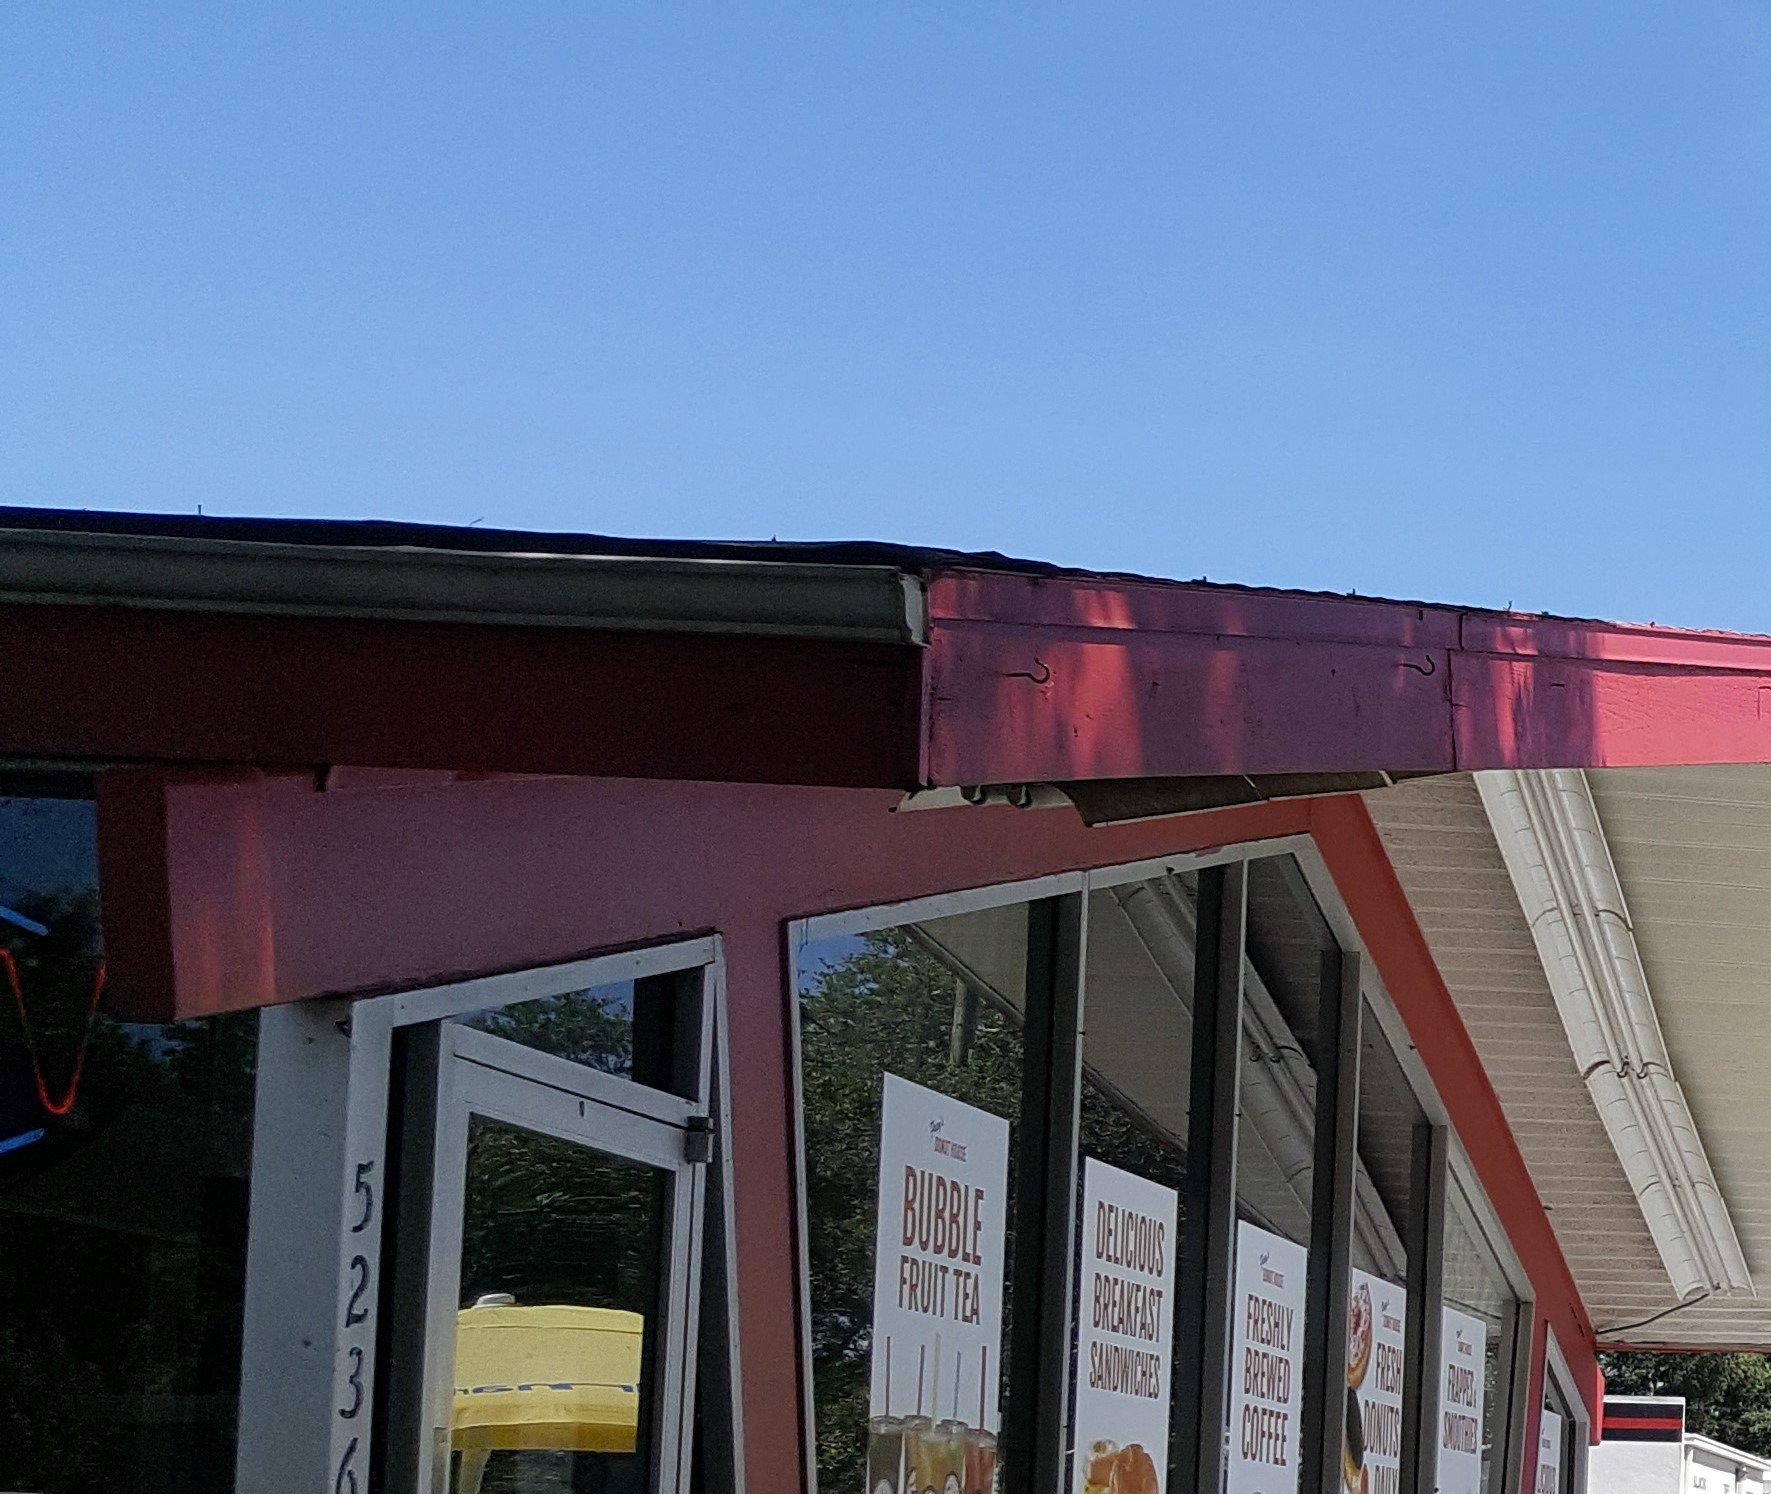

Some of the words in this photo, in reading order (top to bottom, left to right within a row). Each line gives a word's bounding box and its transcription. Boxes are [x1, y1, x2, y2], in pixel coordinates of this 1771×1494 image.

[903, 1164, 985, 1266] BUBBLE
[1095, 1200, 1165, 1278] DELICIOUS
[899, 1254, 949, 1318] FRUIT
[953, 1268, 980, 1325] TEA
[1092, 1272, 1163, 1343] BREAKFAST
[1246, 1293, 1294, 1352] FRESHLY
[1090, 1340, 1161, 1399] SANDWICHES
[1244, 1346, 1290, 1404] BREWED
[1375, 1342, 1402, 1395] FRESH
[1242, 1403, 1288, 1467] COFFEE
[1363, 1400, 1400, 1458] DONUTS
